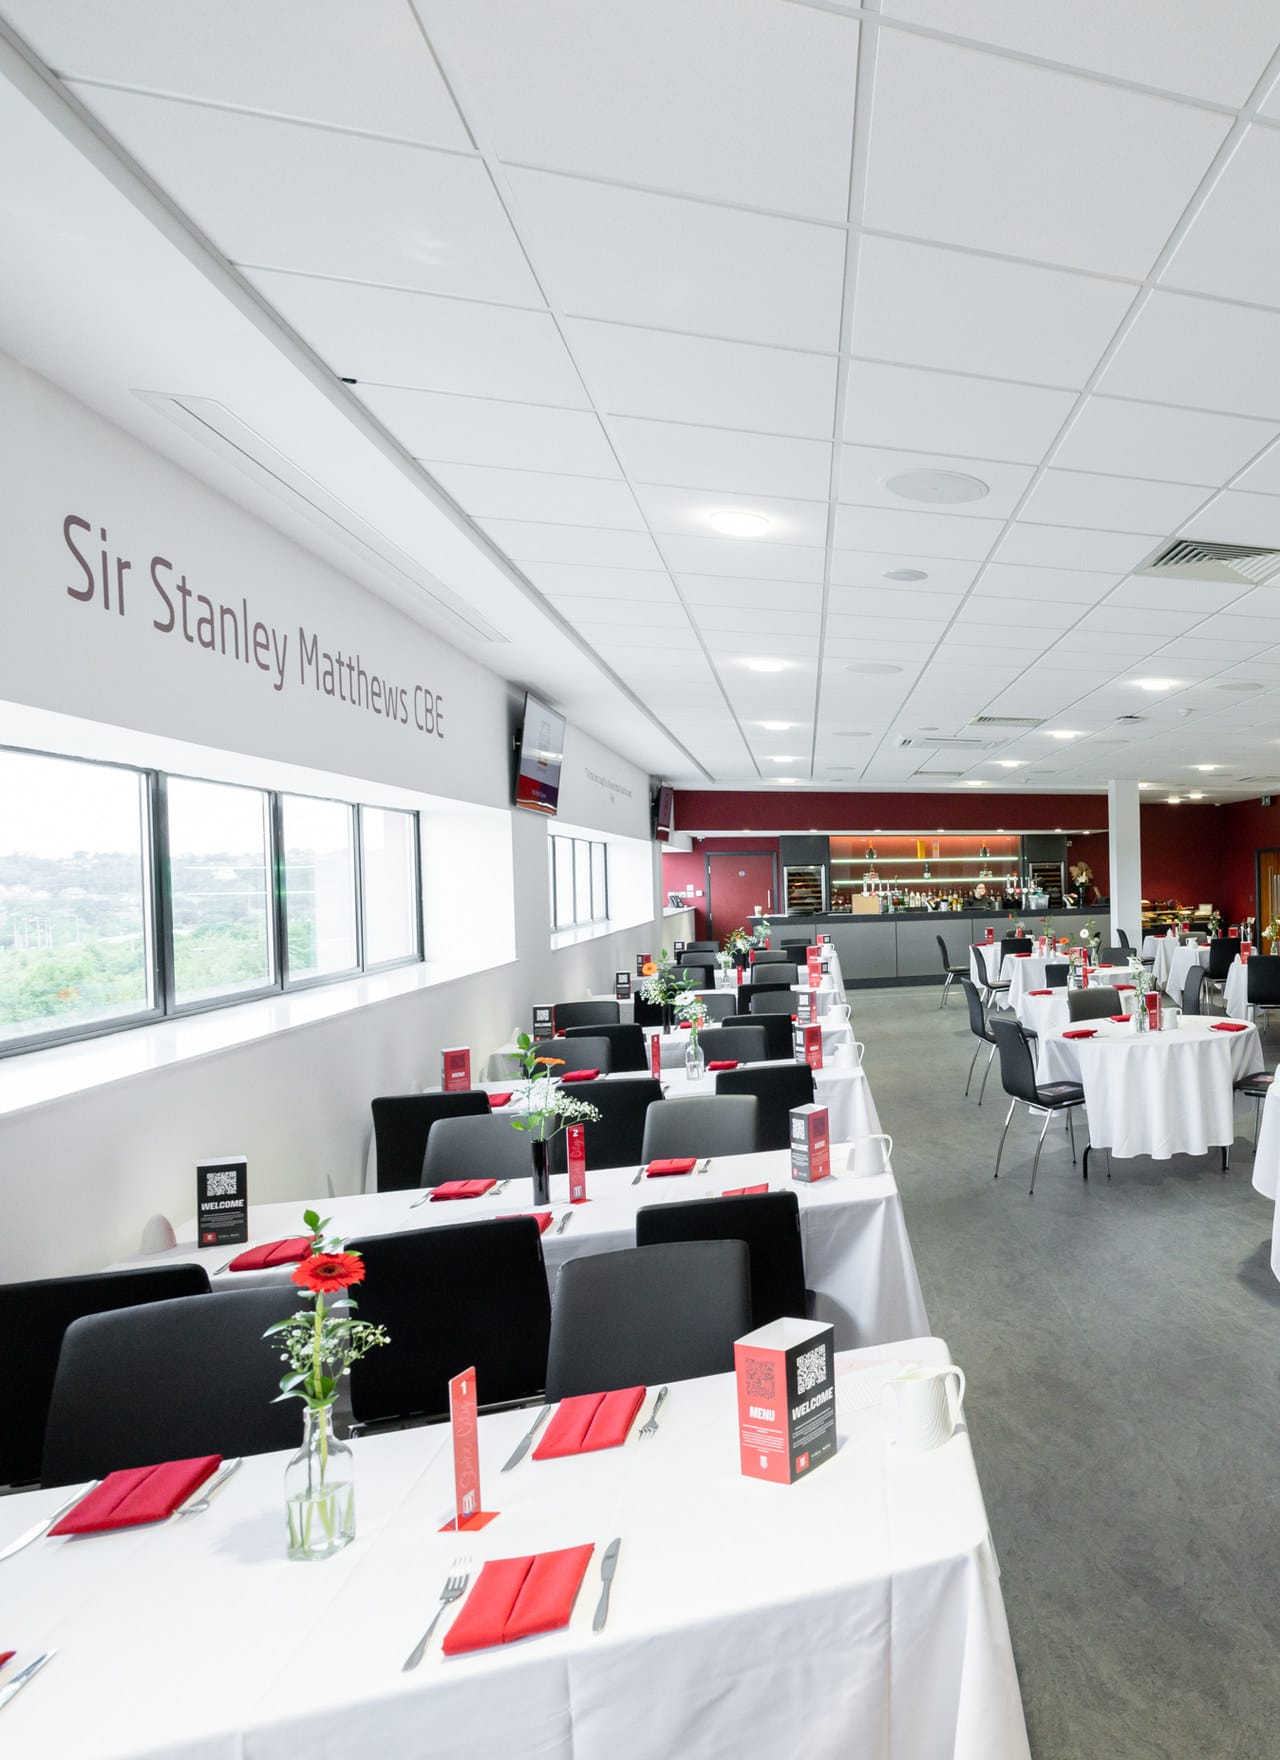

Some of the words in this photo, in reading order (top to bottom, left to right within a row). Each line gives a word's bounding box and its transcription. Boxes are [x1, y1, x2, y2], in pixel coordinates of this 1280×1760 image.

[63, 514, 131, 616] Sir
[150, 556, 287, 691] Stanley
[299, 627, 408, 724] Matthews
[414, 685, 444, 738] CBE
[572, 1128, 579, 1137] 2
[200, 1198, 246, 1211] WELCOME
[460, 1380, 467, 1396] 1
[791, 1386, 834, 1421] WELCOME
[749, 1406, 776, 1422] MENU
